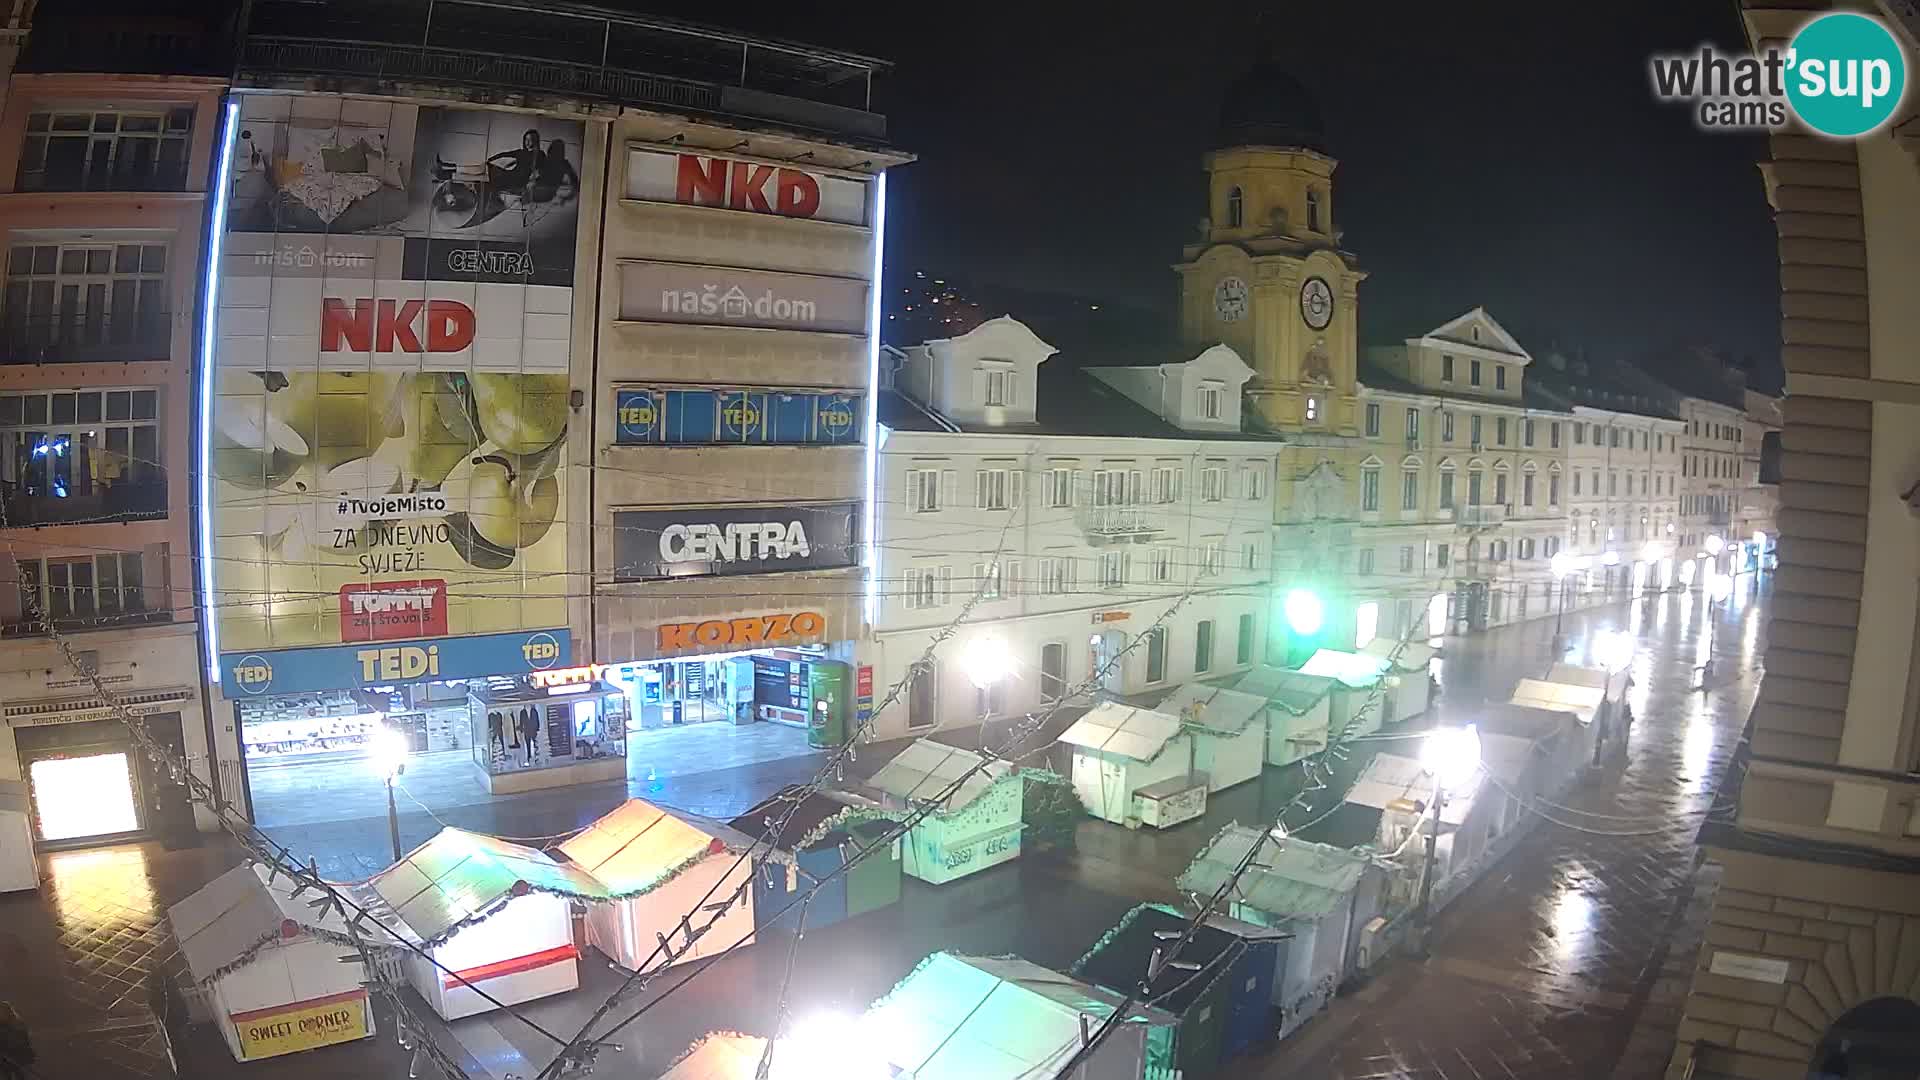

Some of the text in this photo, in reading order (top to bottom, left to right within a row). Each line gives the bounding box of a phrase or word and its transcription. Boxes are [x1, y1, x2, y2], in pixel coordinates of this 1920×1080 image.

[675, 153, 821, 219] NKD
[447, 248, 535, 276] CENTRA
[661, 283, 817, 322] naš dom
[320, 297, 477, 353] NKD
[338, 496, 446, 517] #TvojeMisto
[333, 523, 450, 549] ZA DNEVNO
[659, 520, 811, 563] CENTRA
[358, 547, 425, 575] SVJEŽE
[348, 587, 438, 614] TOMMY
[659, 611, 826, 651] KORZO
[358, 644, 440, 682] TEDi
[522, 643, 560, 660] TEDi
[232, 665, 273, 683] TEDi
[249, 1021, 292, 1042] SWEET
